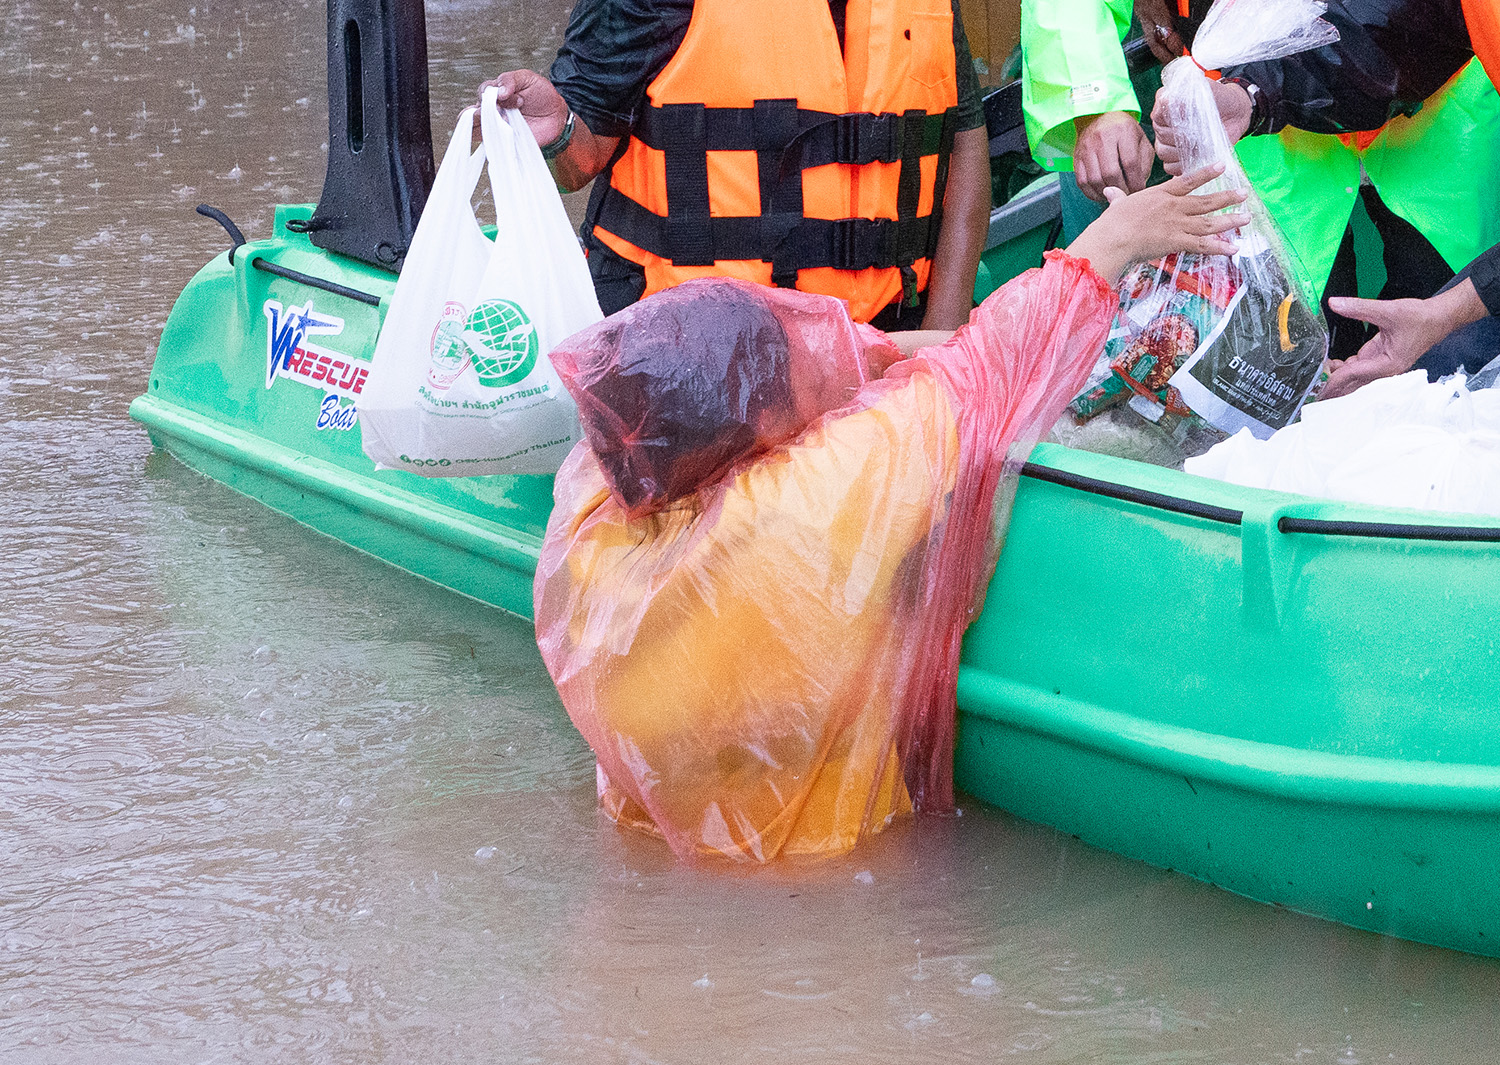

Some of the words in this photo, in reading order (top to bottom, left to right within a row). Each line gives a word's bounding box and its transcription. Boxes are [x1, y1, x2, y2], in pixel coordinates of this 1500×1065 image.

[287, 347, 370, 395] RESCUE
[316, 394, 358, 428] Boat
[461, 383, 550, 412] สำนักจุฬาราชมนต
[530, 435, 572, 452] Thailand
